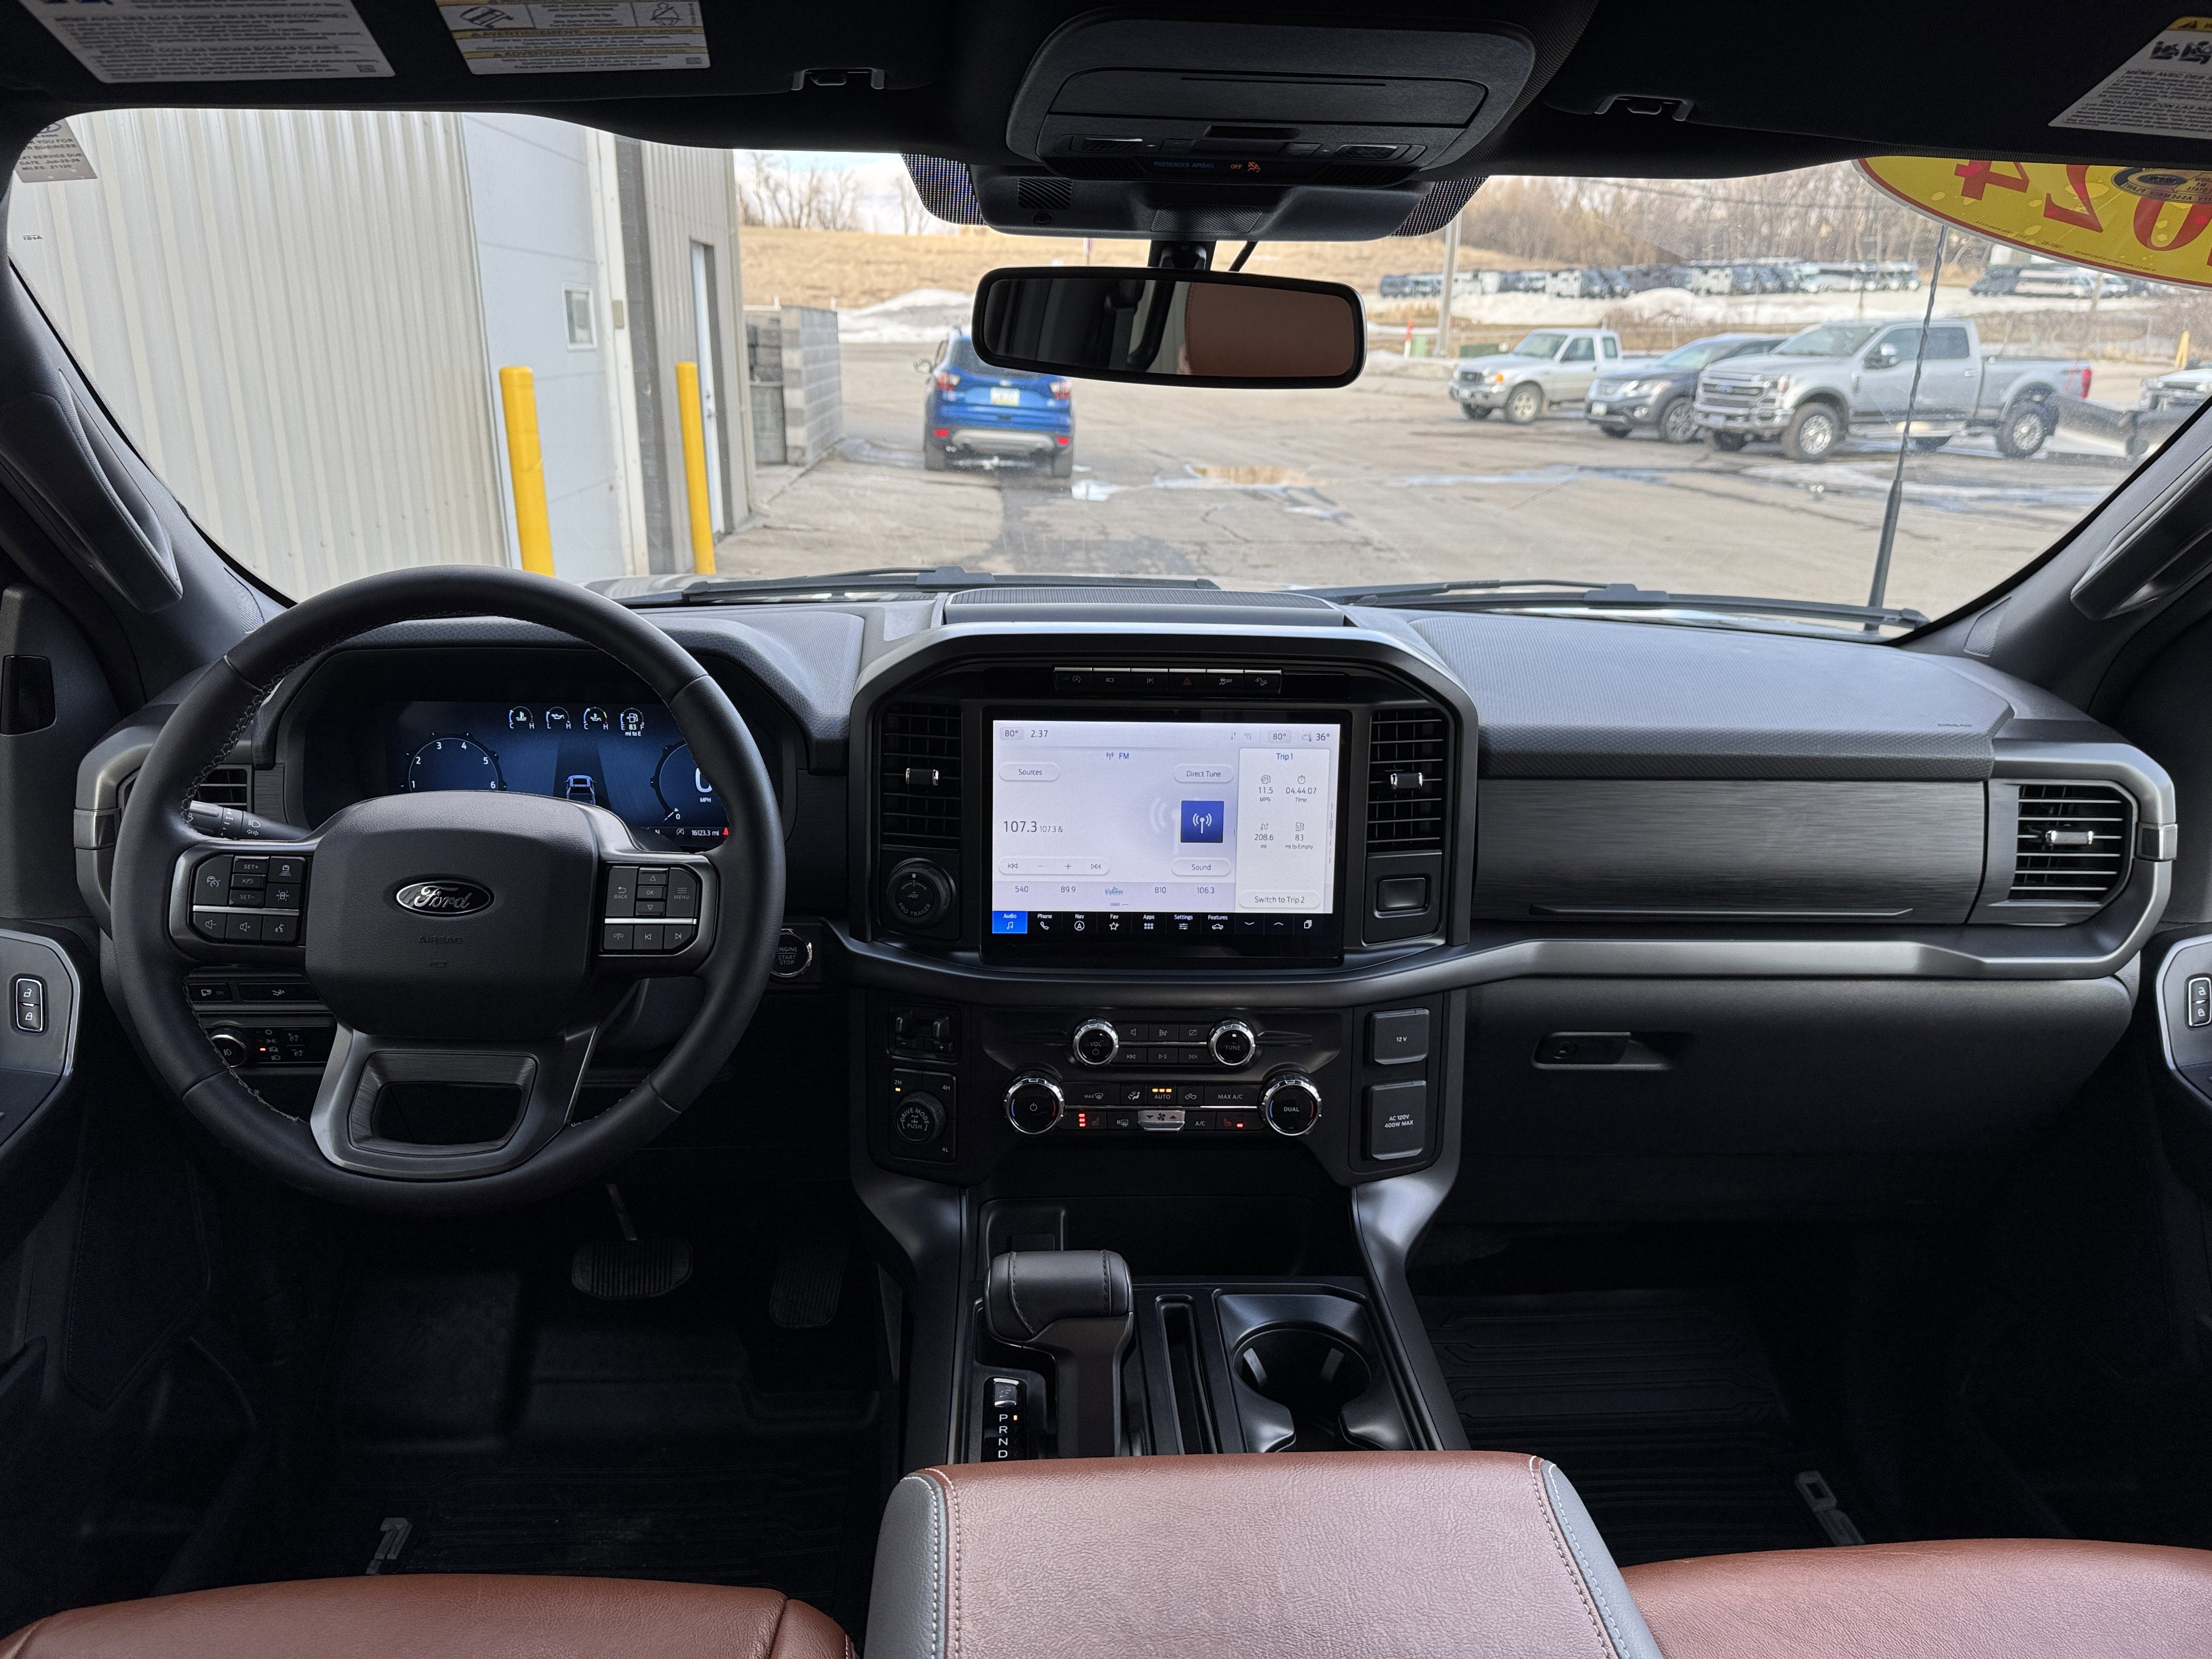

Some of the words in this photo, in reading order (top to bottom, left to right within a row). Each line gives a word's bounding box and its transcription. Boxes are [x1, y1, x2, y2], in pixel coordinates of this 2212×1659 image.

[1316, 733, 1330, 741] 36°
[436, 742, 442, 750] 3
[461, 742, 467, 750] 4
[416, 757, 421, 765] 2
[483, 757, 489, 765] 5
[1276, 753, 1289, 761] Trip
[411, 780, 415, 788] 1
[490, 781, 496, 789] 6
[1003, 821, 1037, 833] 107.3
[413, 885, 473, 910] Ford
[1286, 896, 1299, 905] Trip
[898, 902, 909, 914] PRO
[910, 902, 932, 917] TRAILER
[417, 935, 463, 945] AIRBAG
[900, 1108, 914, 1122] DRIVE
[915, 1108, 929, 1124] MODE
[998, 1414, 1008, 1423] P
[998, 1425, 1008, 1434] R
[998, 1437, 1008, 1446] N
[998, 1449, 1008, 1458] D
